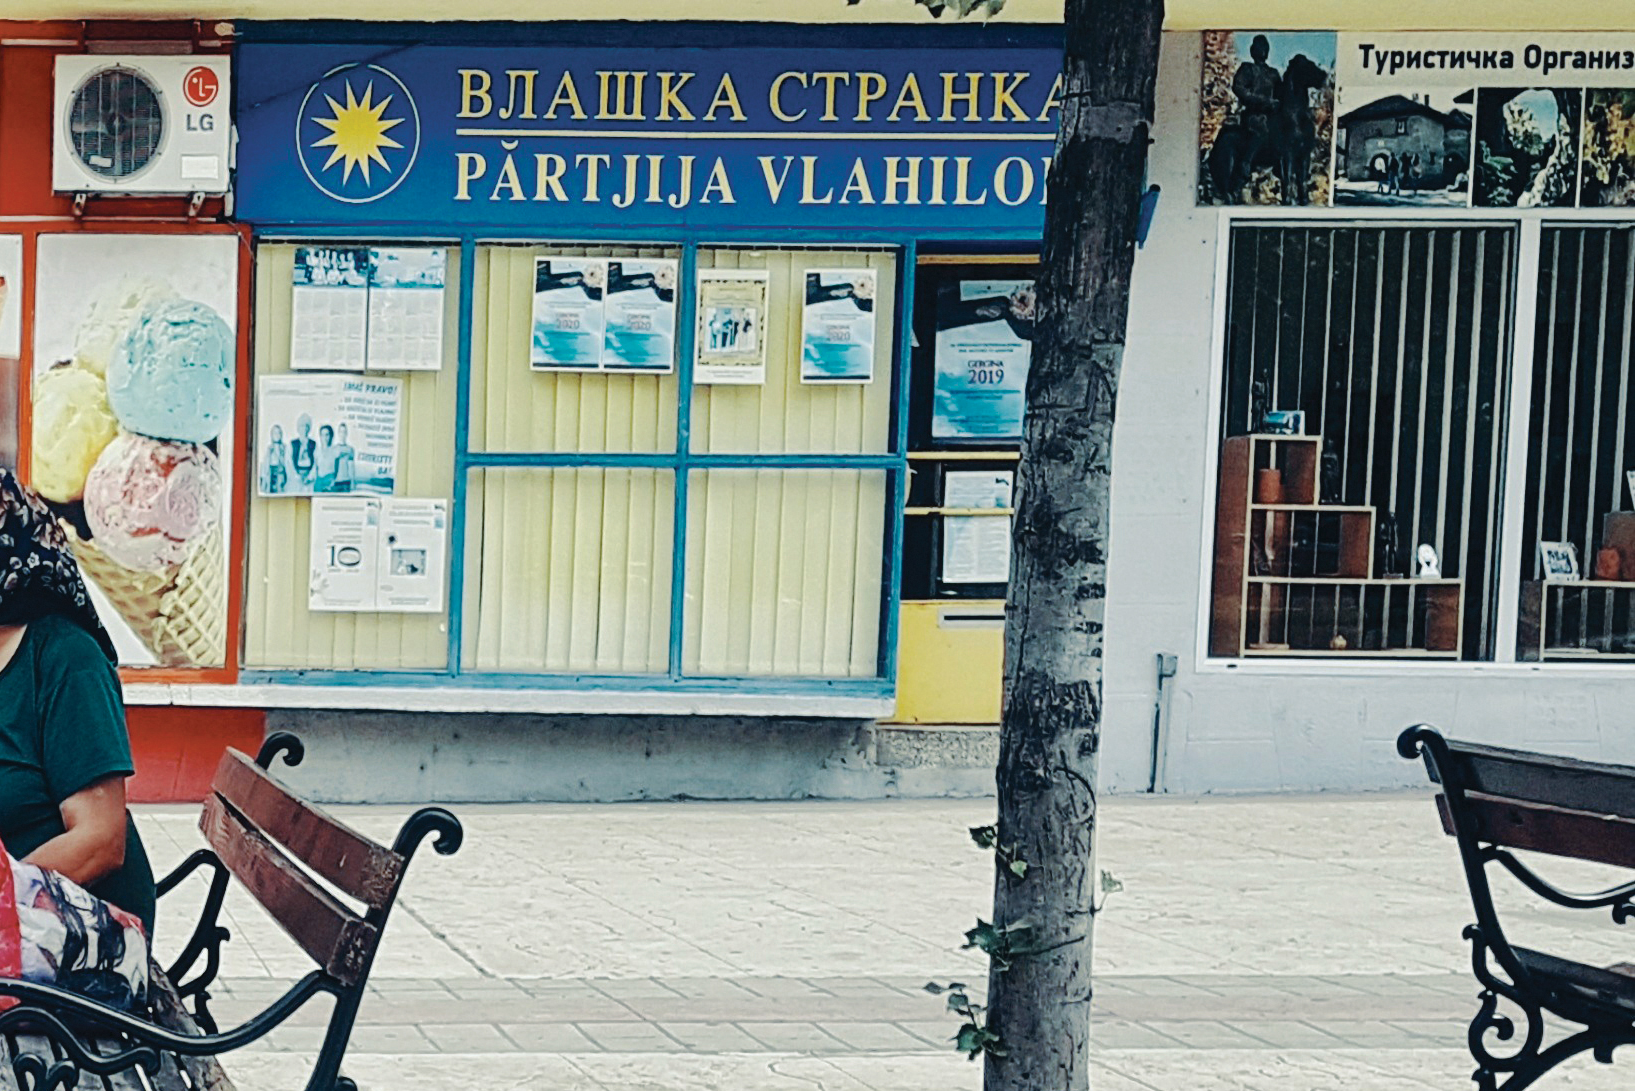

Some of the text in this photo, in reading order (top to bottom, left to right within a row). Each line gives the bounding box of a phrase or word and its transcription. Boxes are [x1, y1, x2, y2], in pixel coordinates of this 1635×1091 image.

[1358, 43, 1635, 76] Туристичка Организ
[455, 68, 748, 122] ВЛАШКА
[185, 112, 215, 132] LG
[452, 139, 738, 209] PĂRTJIJA
[967, 369, 1005, 385] 2019
[326, 545, 362, 567] 10
